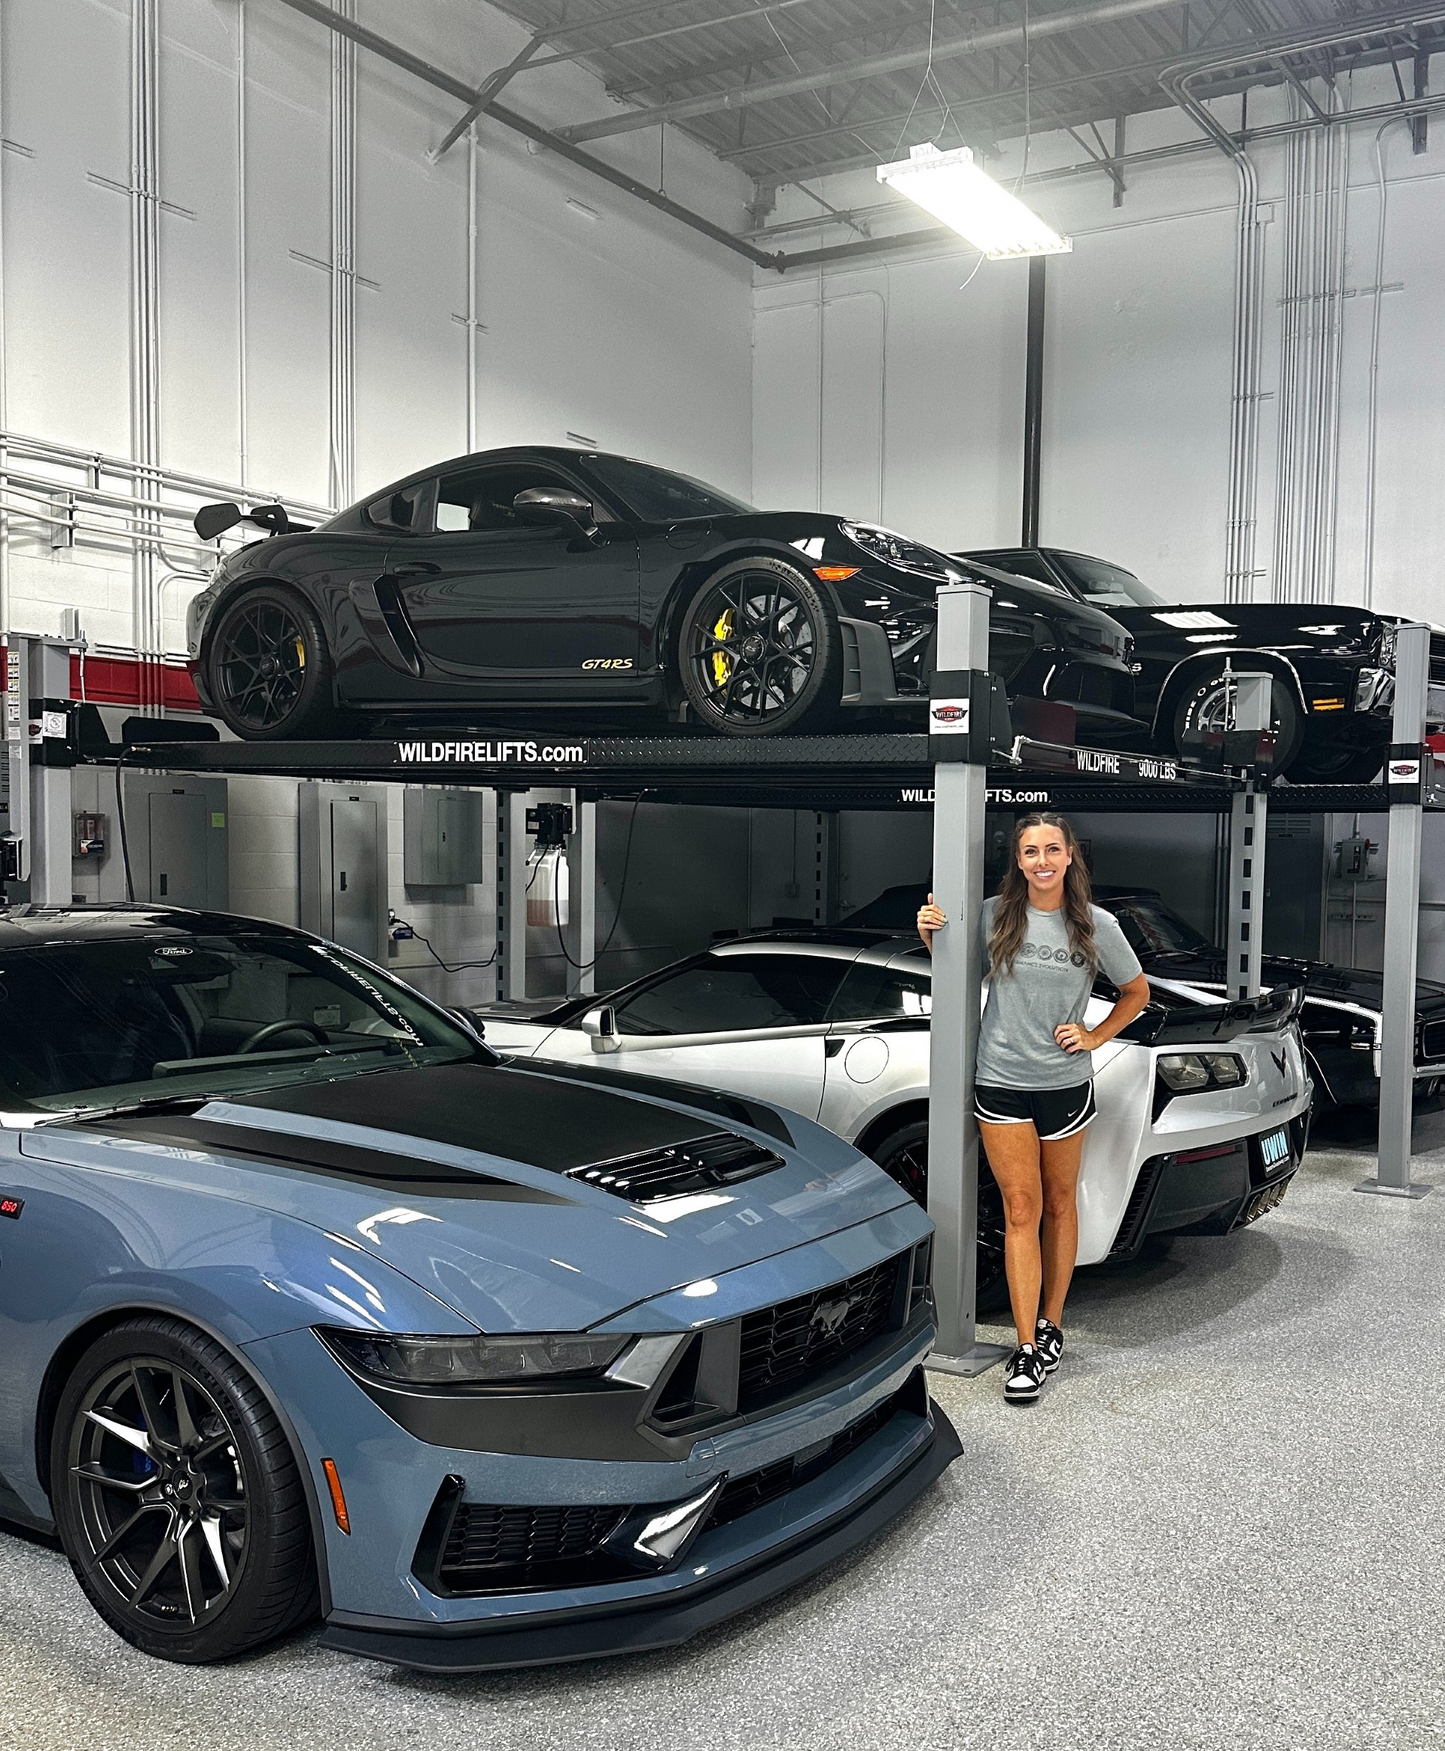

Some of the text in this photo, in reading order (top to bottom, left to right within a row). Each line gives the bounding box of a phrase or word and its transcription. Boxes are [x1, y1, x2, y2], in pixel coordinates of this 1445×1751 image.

[581, 658, 633, 670] GT4RS
[399, 742, 583, 762] WILDFIRELIFTS.com
[1077, 751, 1176, 780] WILDFIRE 9000 LBS
[901, 789, 1048, 803] WILDFTS.com
[1261, 1131, 1289, 1166] UWIN
[1, 1200, 18, 1213] 850
